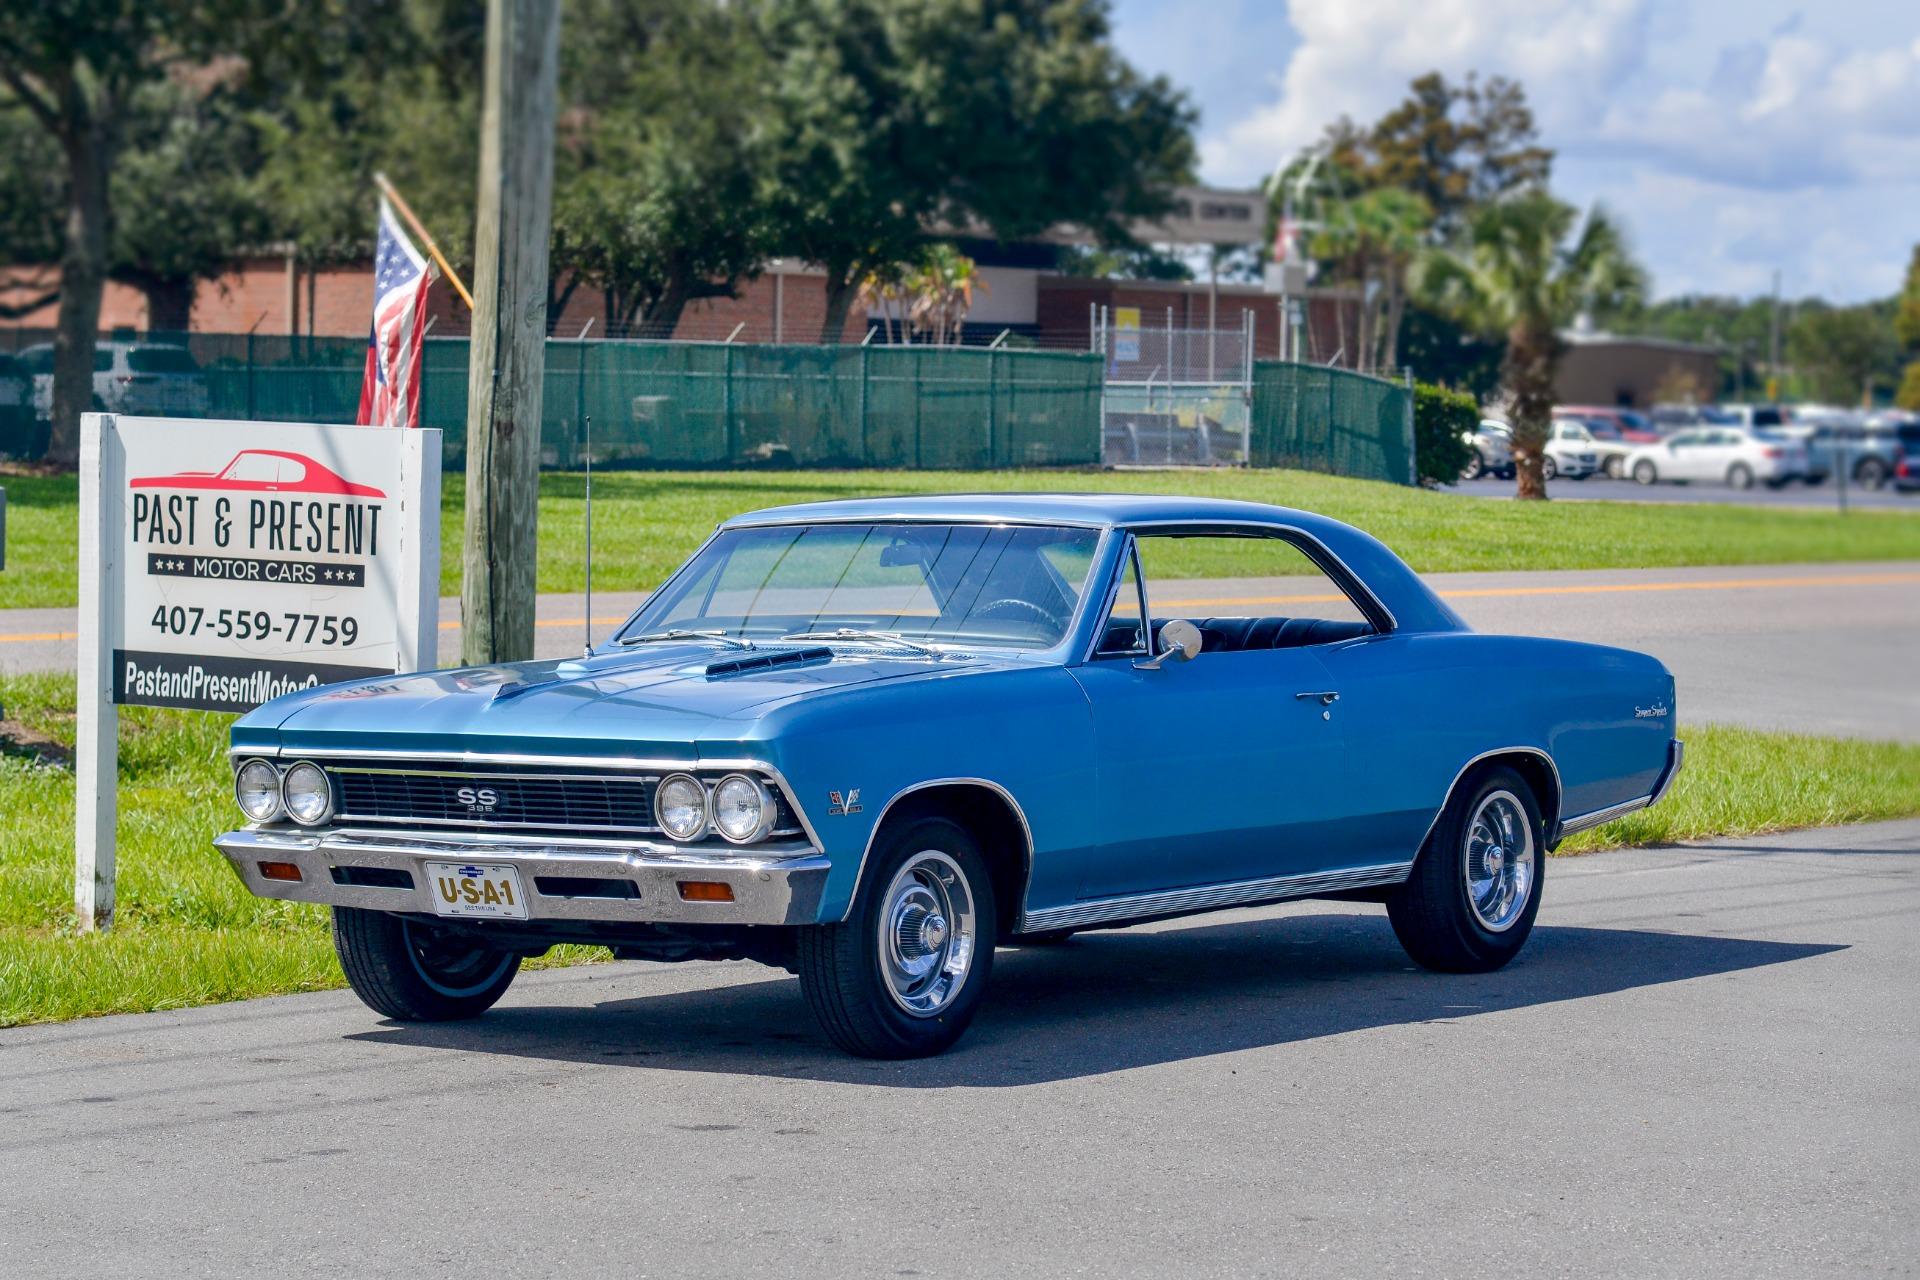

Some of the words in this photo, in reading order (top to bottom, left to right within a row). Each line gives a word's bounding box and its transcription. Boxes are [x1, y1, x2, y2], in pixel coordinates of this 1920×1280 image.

[132, 493, 199, 546] PAST
[214, 497, 232, 547] &
[249, 499, 382, 556] PRESENT
[193, 558, 259, 581] MOTOR
[265, 562, 316, 583] CARS
[151, 604, 359, 647] 407-559-7759
[125, 661, 325, 704] PastandPresentMot
[457, 787, 497, 806] SS
[467, 804, 493, 812] 396
